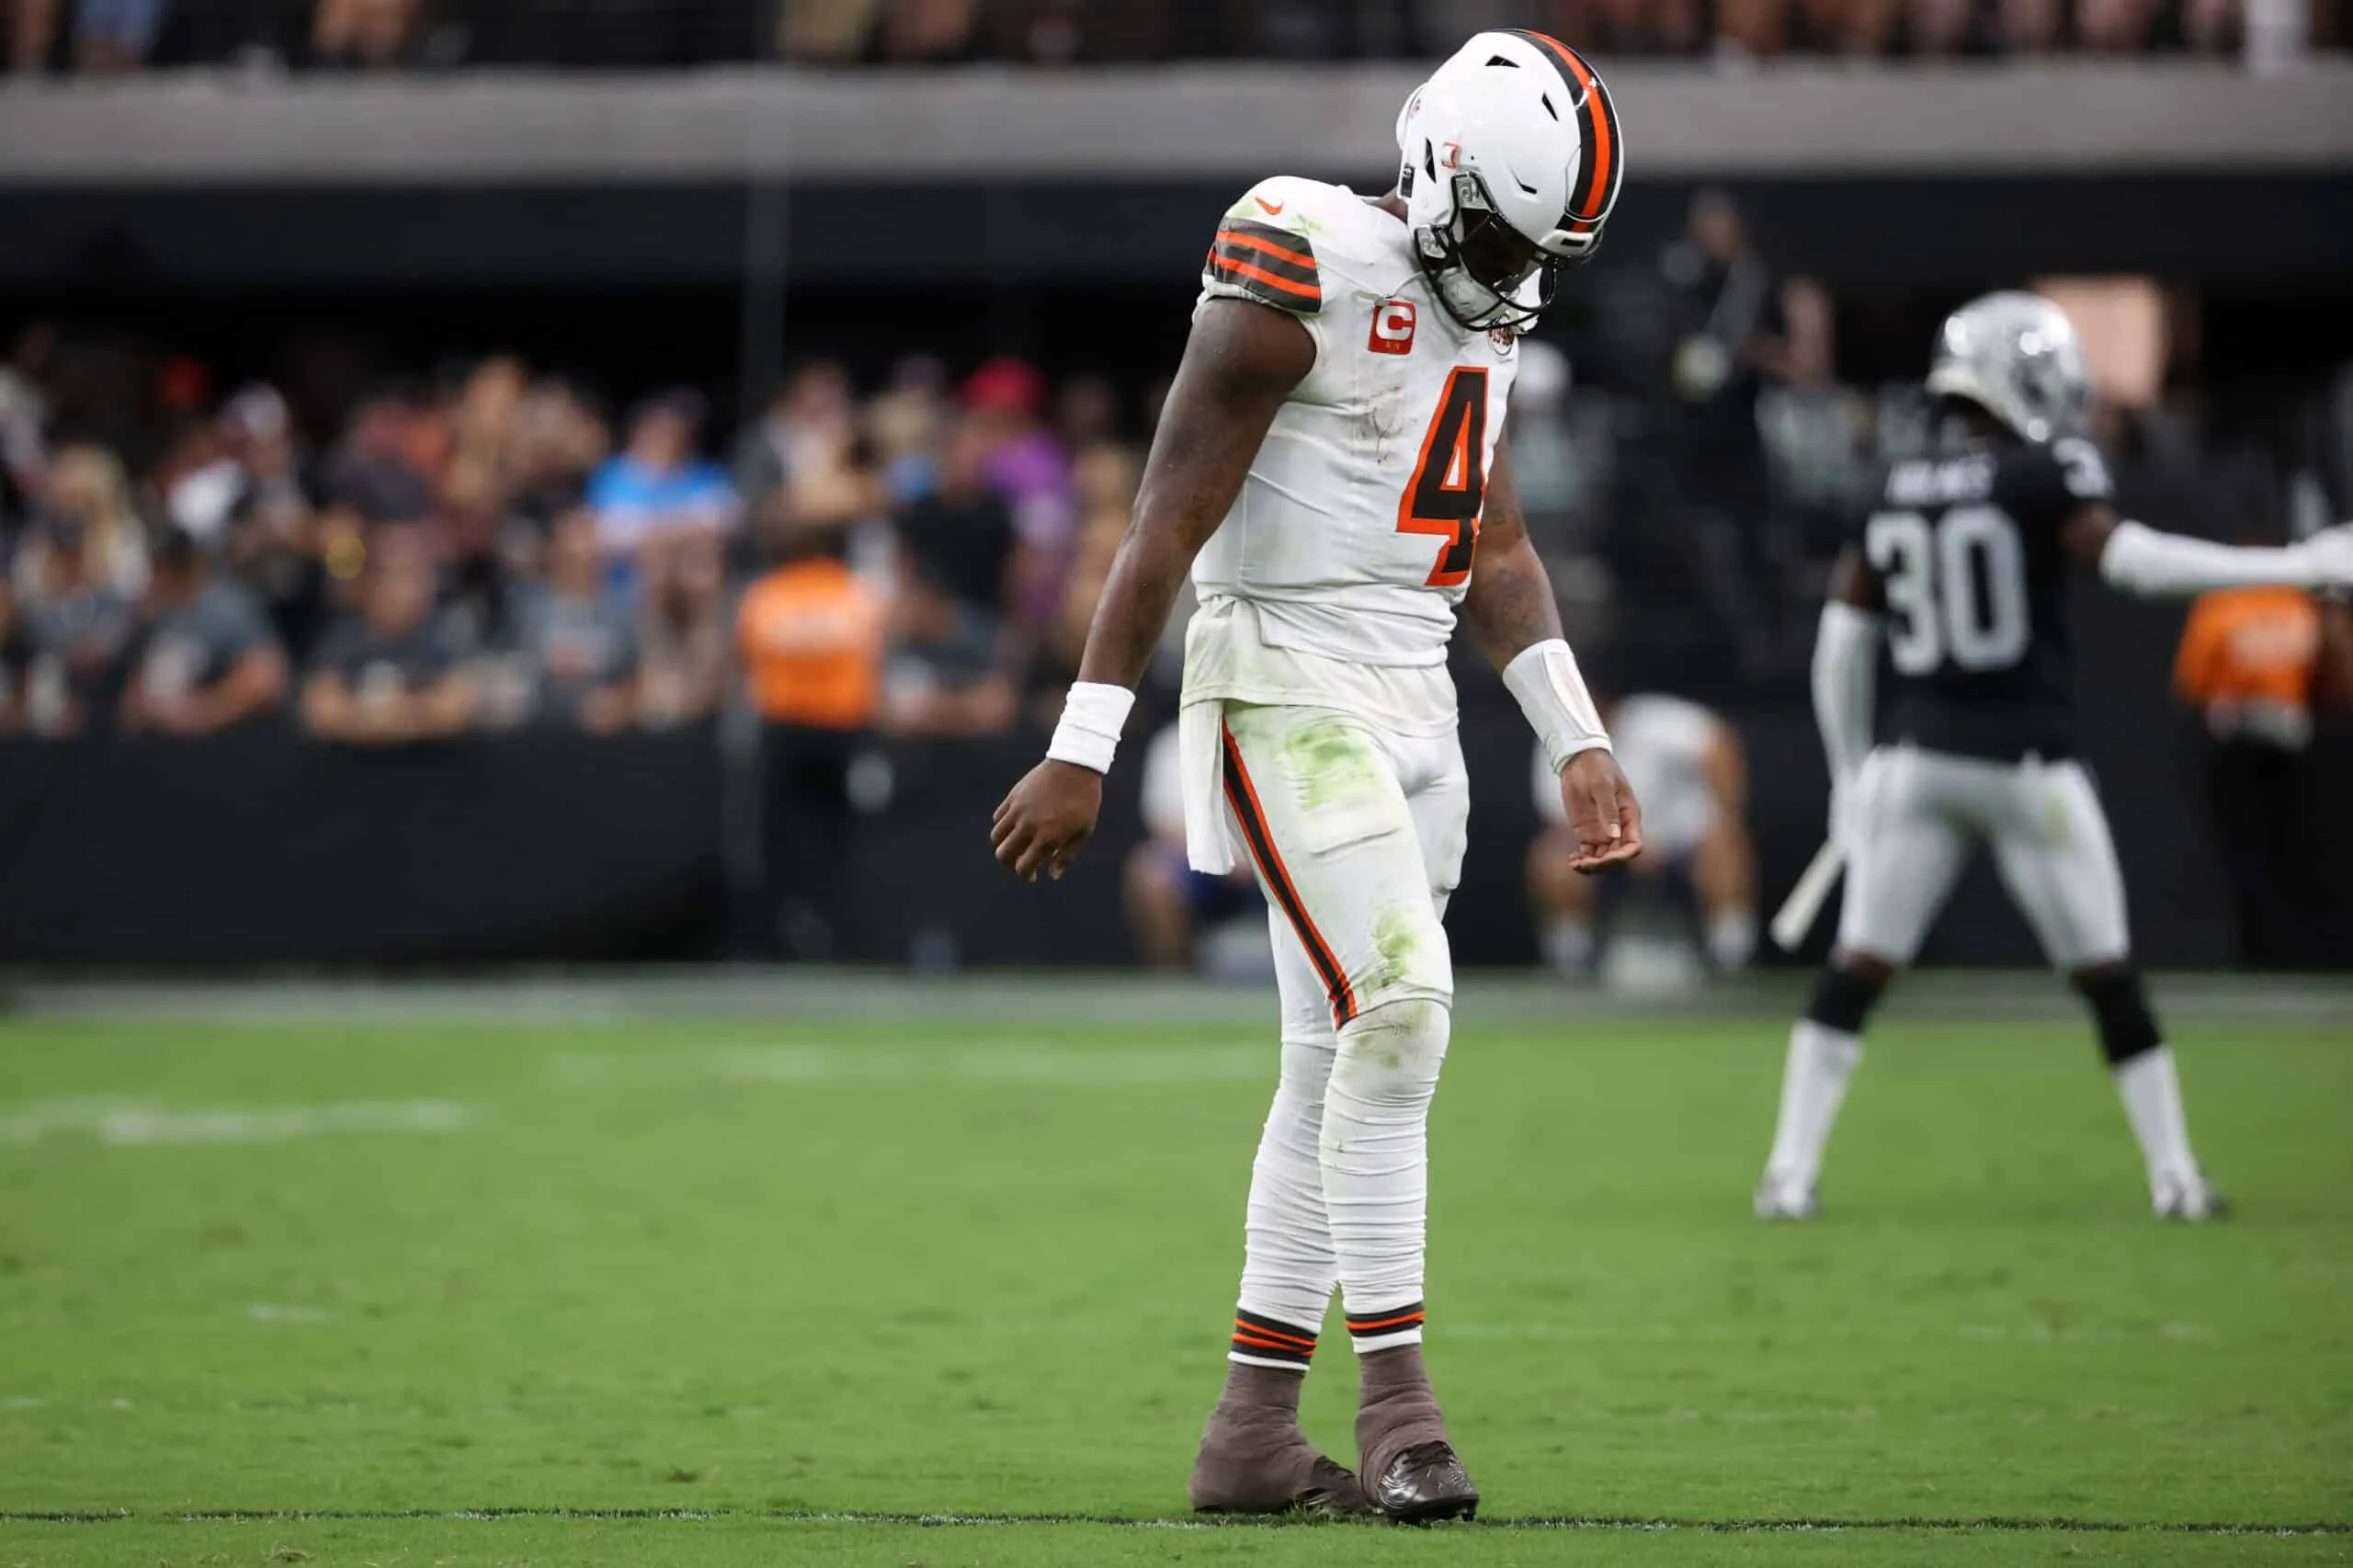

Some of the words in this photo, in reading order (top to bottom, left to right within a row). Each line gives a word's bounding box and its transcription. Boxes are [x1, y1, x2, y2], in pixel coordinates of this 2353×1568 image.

[1376, 305, 1414, 341] C
[1396, 365, 1488, 586] 4
[1866, 506, 2030, 676] 30
